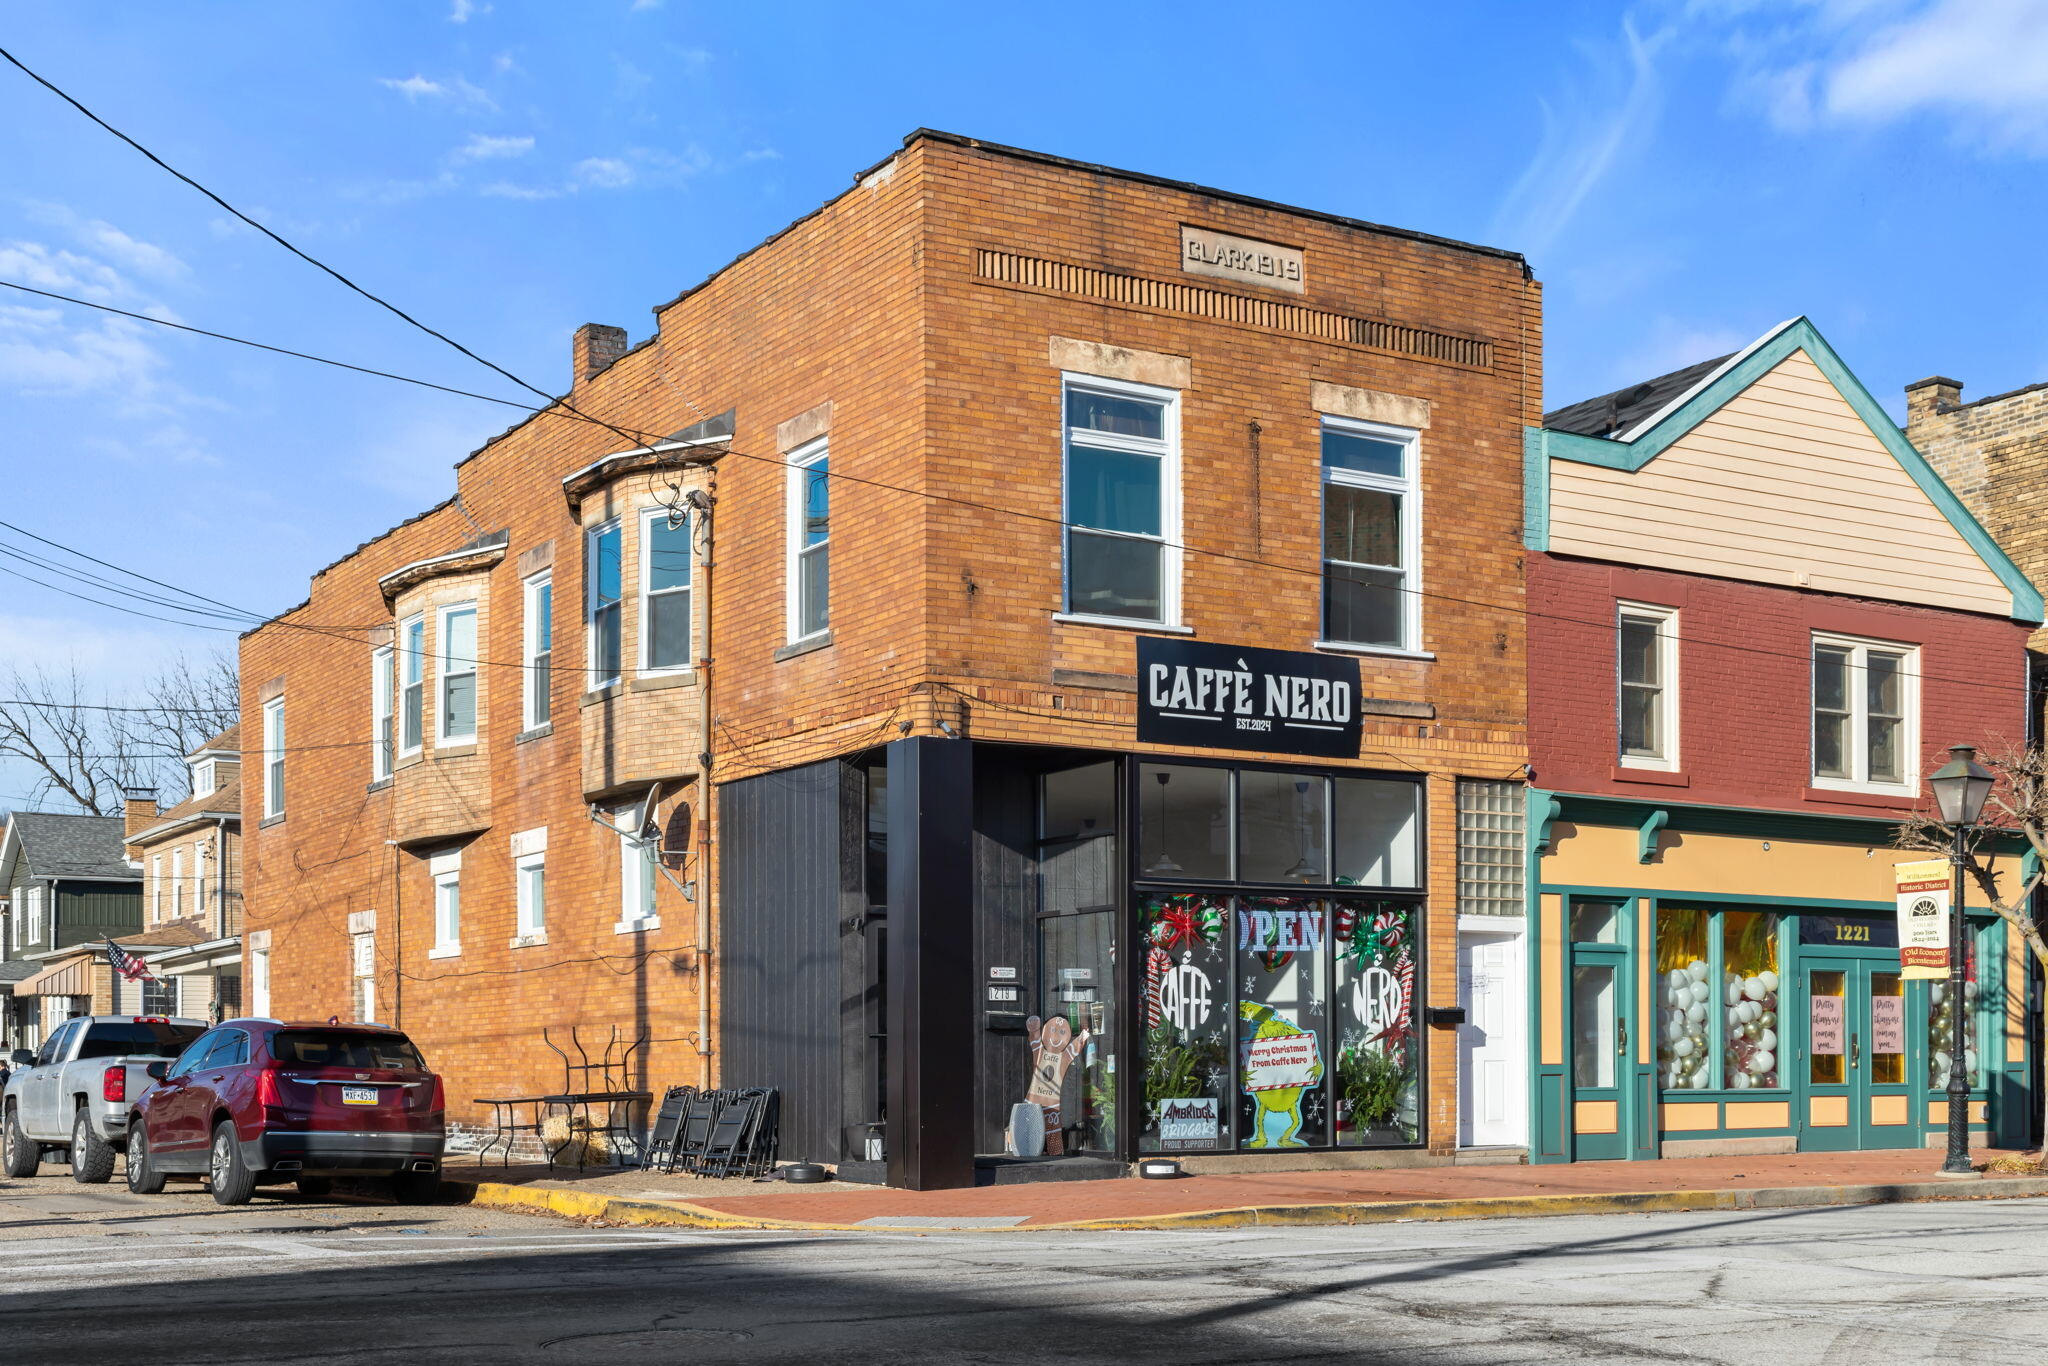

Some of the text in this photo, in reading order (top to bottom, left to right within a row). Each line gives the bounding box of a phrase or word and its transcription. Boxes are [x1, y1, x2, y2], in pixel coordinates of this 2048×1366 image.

[1188, 241, 1300, 281] CLARK 1919
[1149, 658, 1351, 723] CAFFÈ NERO
[1236, 717, 1272, 732] EST.2024
[1925, 881, 1946, 889] District
[1835, 925, 1871, 942] 1221
[989, 987, 1010, 1000] 1219
[1248, 1045, 1308, 1056] Merry Christmas
[1163, 1100, 1216, 1124] AMBRIDGE
[1164, 1140, 1215, 1149] PROUD SUPPORTER
